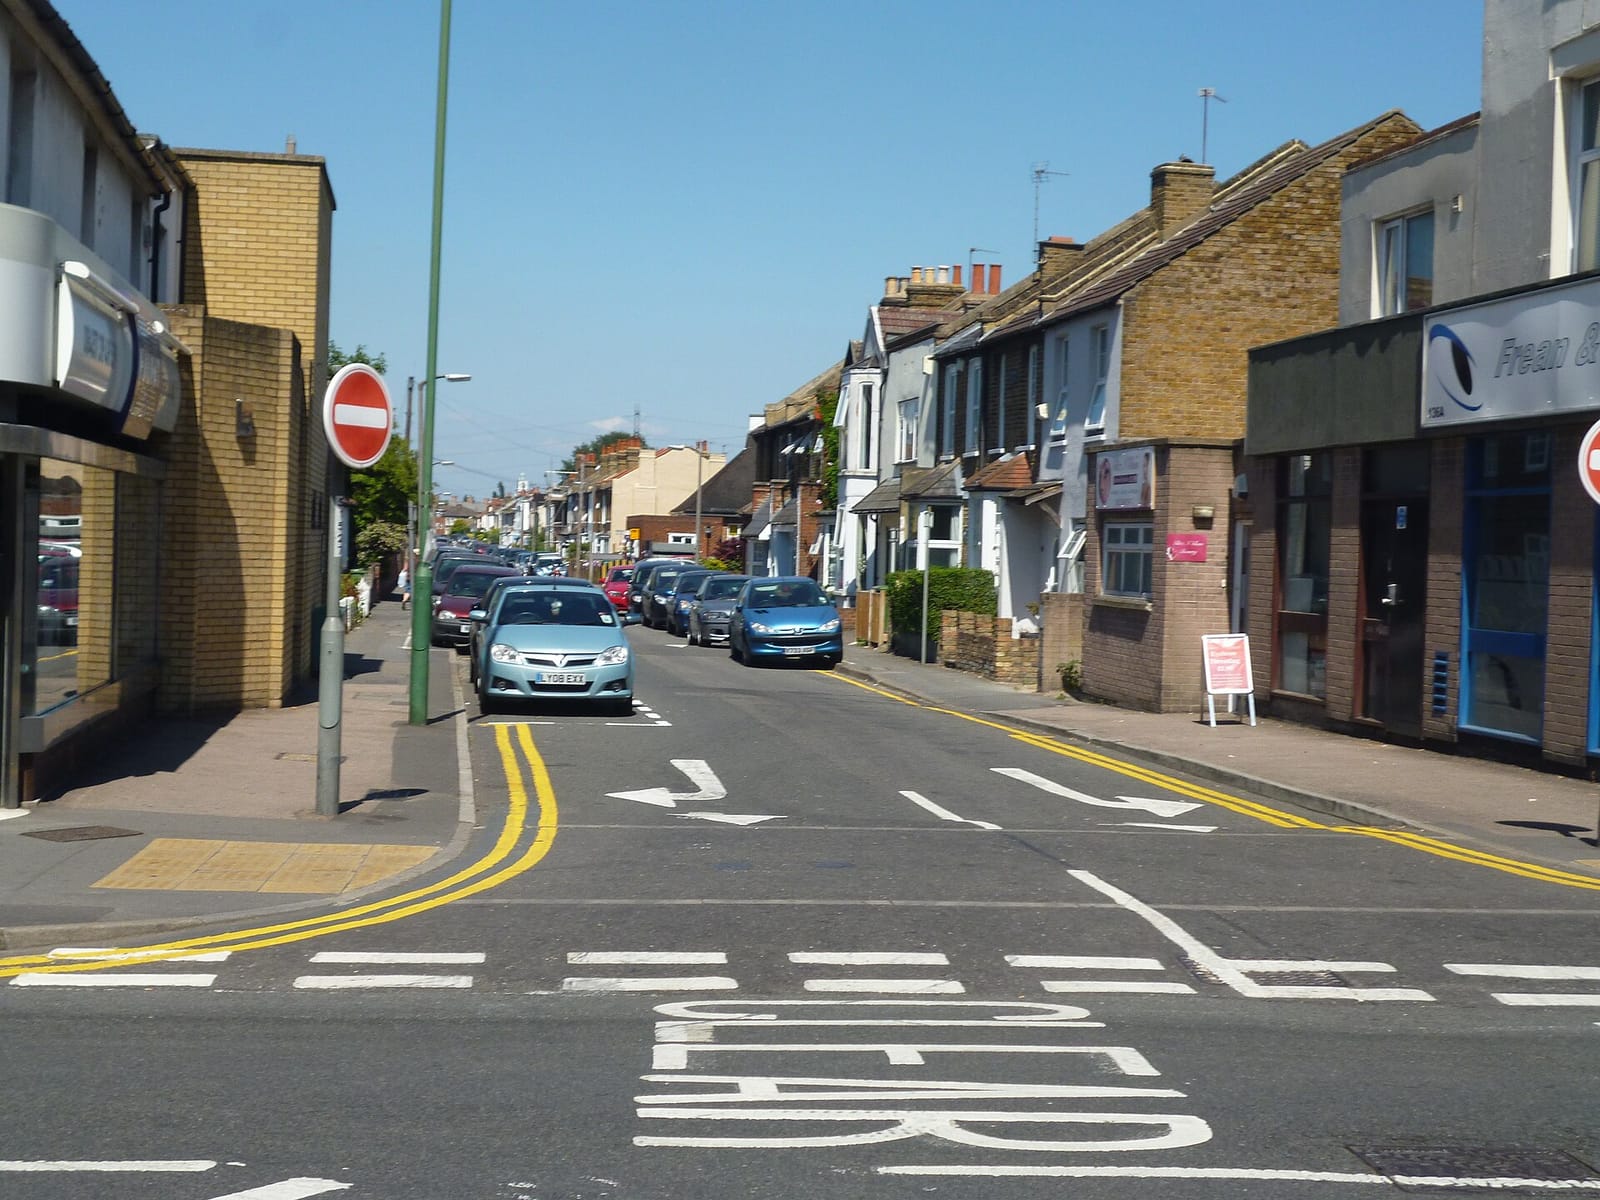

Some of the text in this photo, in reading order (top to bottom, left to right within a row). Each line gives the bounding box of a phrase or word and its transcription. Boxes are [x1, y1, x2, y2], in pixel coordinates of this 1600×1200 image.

[1494, 321, 1600, 378] Frean &
[633, 1000, 1213, 1152] CLEAR
